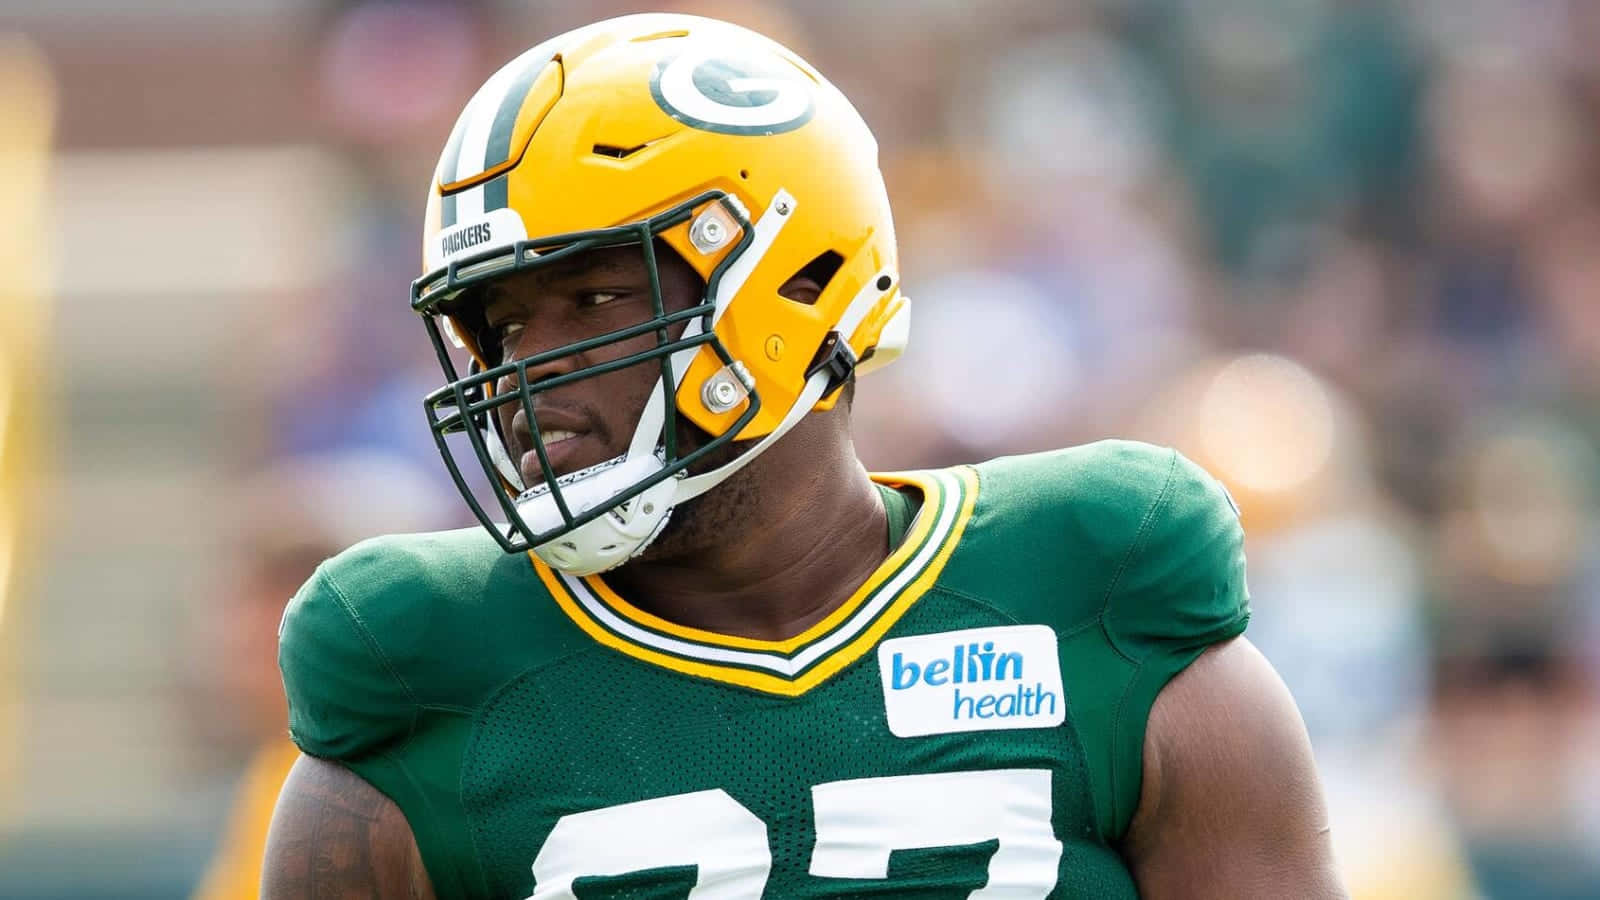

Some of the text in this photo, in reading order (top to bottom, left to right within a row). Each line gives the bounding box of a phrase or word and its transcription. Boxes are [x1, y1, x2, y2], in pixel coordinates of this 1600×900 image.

[656, 50, 811, 128] G
[441, 222, 491, 257] PACKERS
[891, 641, 1024, 690] bellin
[953, 682, 1056, 720] health
